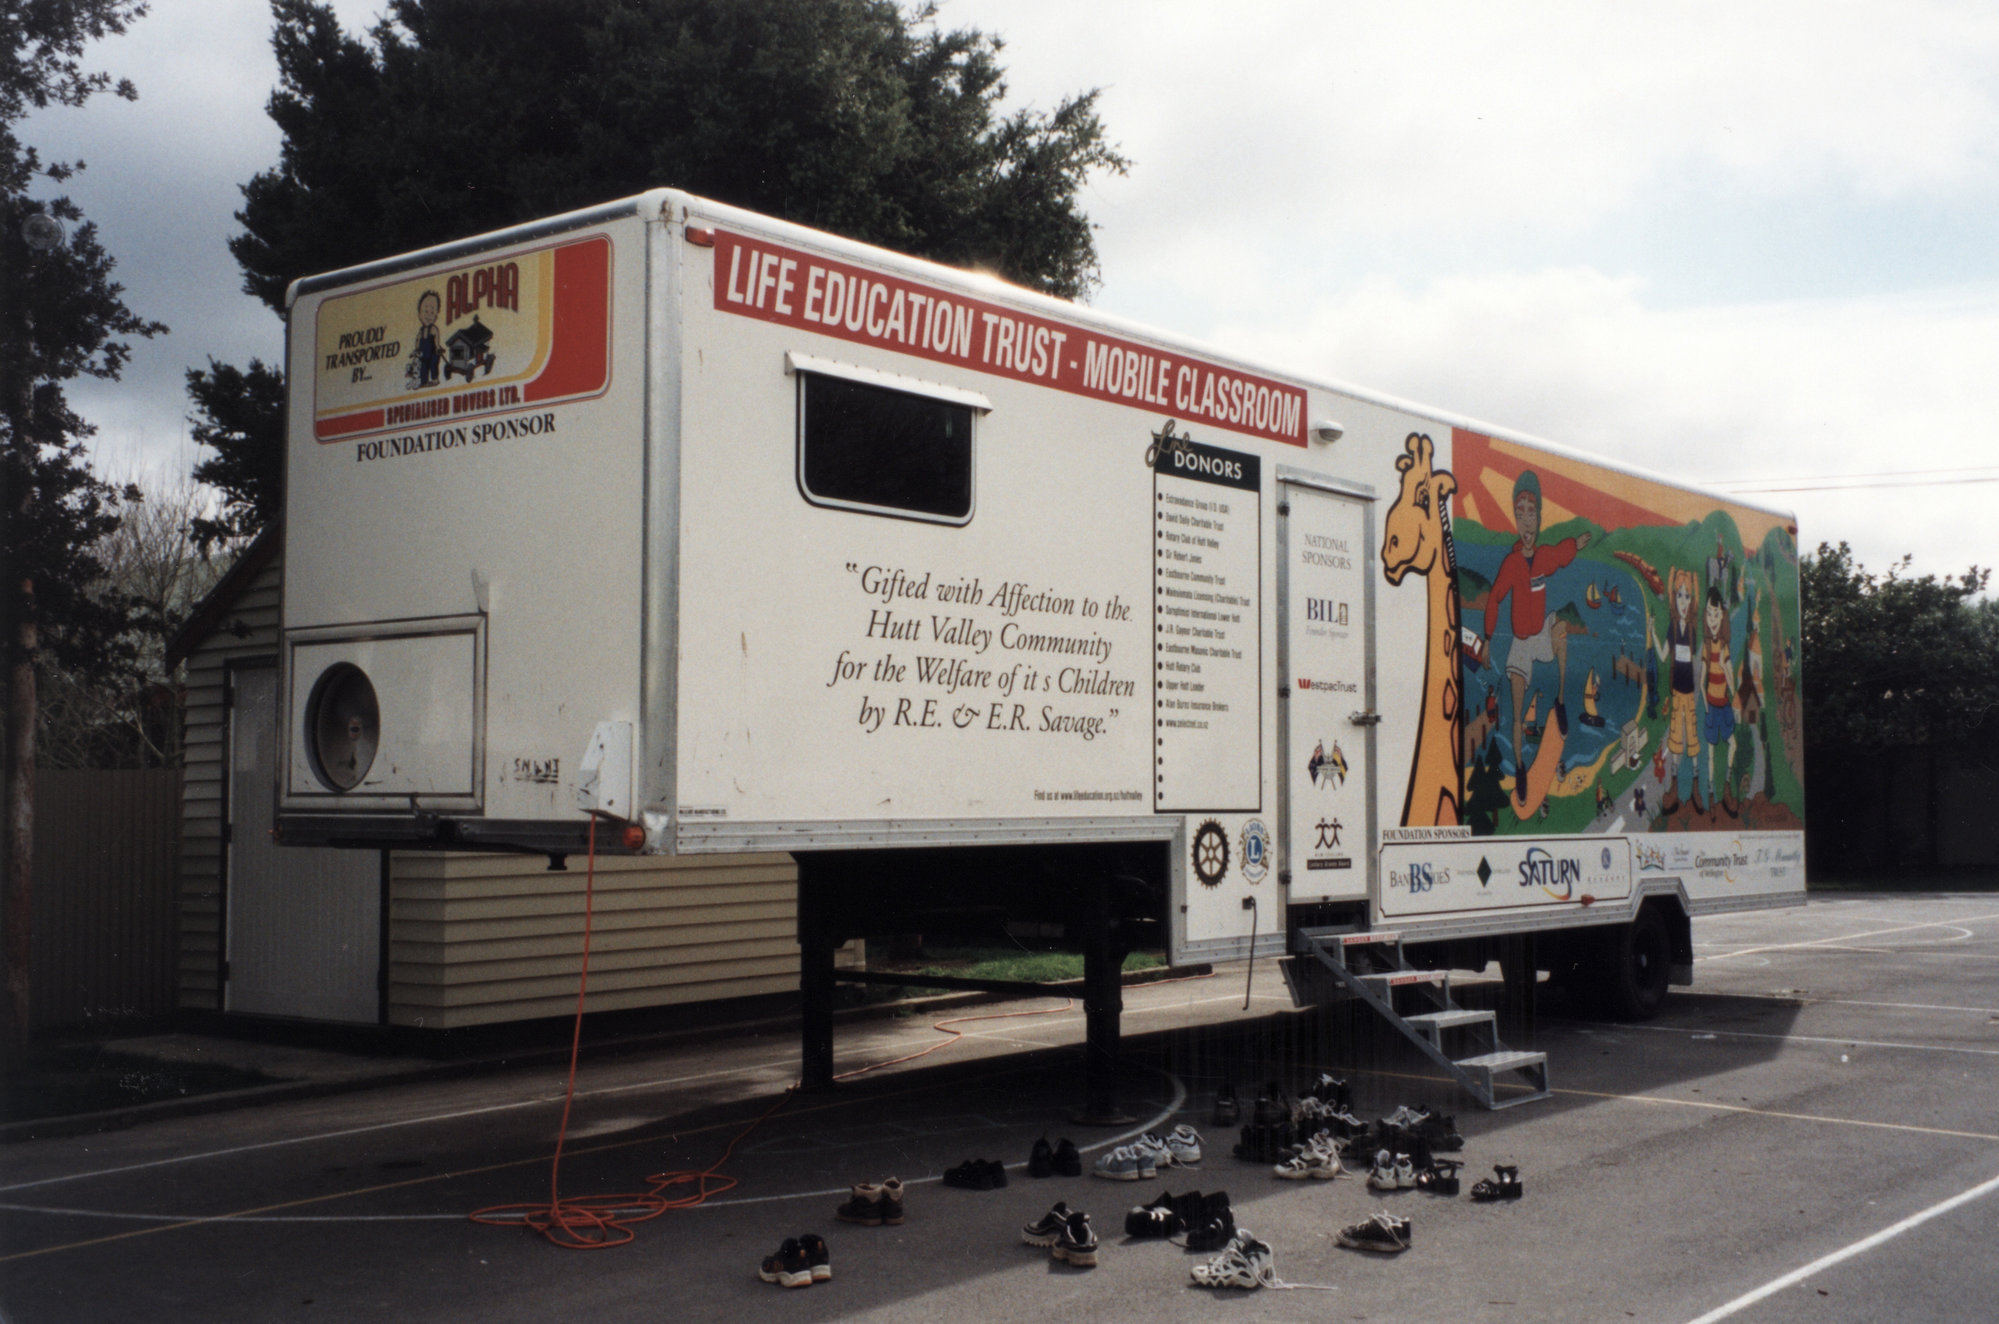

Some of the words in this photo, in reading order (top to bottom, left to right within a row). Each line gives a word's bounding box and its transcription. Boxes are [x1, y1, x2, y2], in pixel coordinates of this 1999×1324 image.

[446, 262, 519, 326] ALPHA
[339, 326, 387, 349] PROUDLY
[727, 245, 797, 315] LIFE
[804, 265, 974, 359] EDUCATION
[982, 312, 1067, 379] TRUST
[1083, 340, 1171, 406] MOBILE
[1176, 365, 1302, 438] CLASSROOM
[326, 341, 400, 370] TRANSPORTED
[387, 397, 450, 425] SPECIALISED
[453, 388, 496, 414] MOVERS
[499, 385, 520, 406] LTD.
[357, 428, 467, 462] FOUNDATION
[472, 413, 556, 444] SPONSOR
[1174, 450, 1242, 480] DONORS
[1305, 533, 1349, 553] NATIONAL
[1302, 550, 1352, 570] SPONSORS
[937, 576, 983, 606] with
[987, 581, 1075, 617] Affection
[1081, 597, 1099, 619] to
[866, 609, 921, 641] Hutt
[931, 615, 992, 654] Valley
[1000, 623, 1112, 664] Community
[826, 650, 867, 687] for
[873, 654, 906, 683] the
[916, 656, 992, 694] Welfare
[998, 663, 1022, 698] of
[1058, 667, 1135, 697] Children
[1298, 678, 1357, 693] WestpacTrust
[858, 695, 885, 734] by
[893, 698, 942, 728] R.E.
[953, 703, 980, 729] &
[986, 702, 1030, 731] E.R.
[1383, 829, 1432, 840] FOUNDATION
[1435, 828, 1470, 840] SPONSORS
[1250, 839, 1260, 859] L
[1695, 855, 1731, 869] Community
[1733, 853, 1747, 866] Trust
[1519, 859, 1580, 887] SATURN
